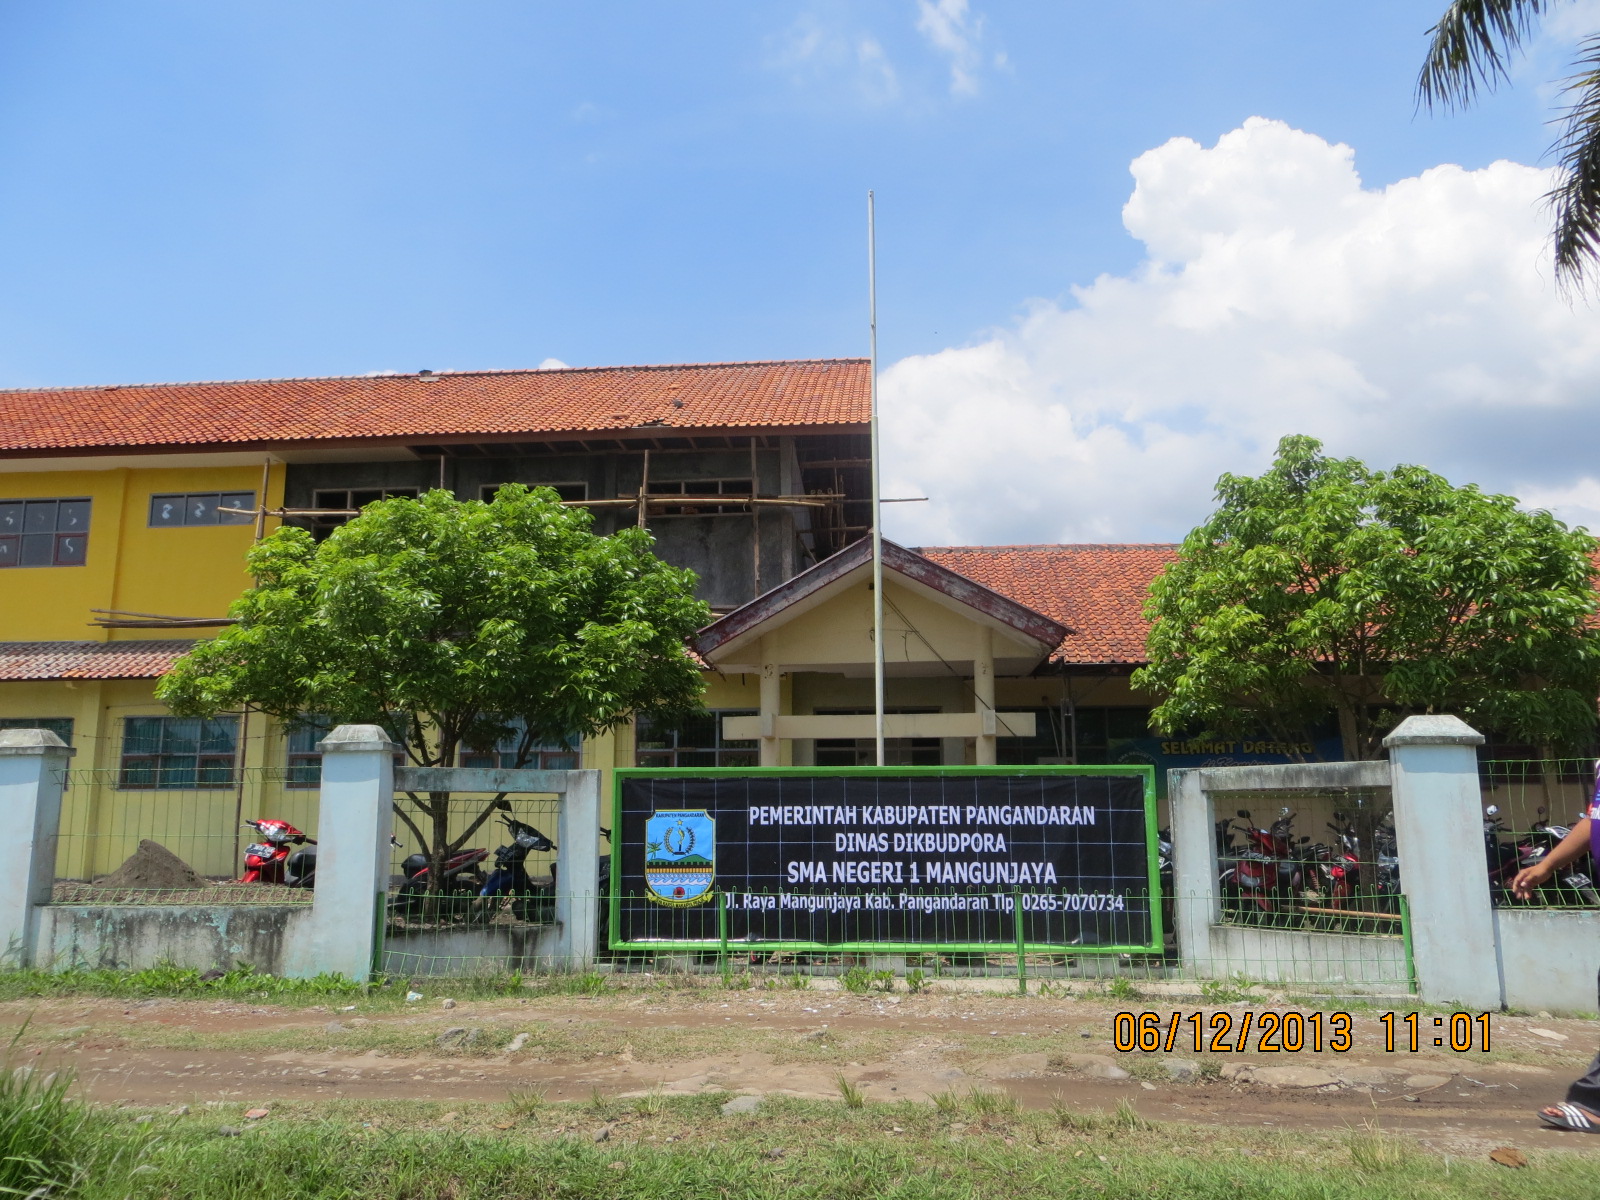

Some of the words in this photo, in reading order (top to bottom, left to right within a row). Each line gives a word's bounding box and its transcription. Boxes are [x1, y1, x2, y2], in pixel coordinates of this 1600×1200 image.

[1161, 740, 1236, 755] SELAMAT
[749, 806, 857, 825] PEMERINTAH
[862, 806, 961, 825] KABUPATEN
[966, 806, 1095, 825] PANGANDARAN
[835, 833, 889, 852] DINAS
[894, 833, 1006, 853] DIKBUDPORA
[787, 861, 828, 883] SMA
[833, 861, 903, 883] NEGERI
[909, 861, 920, 883] 1
[926, 861, 1057, 884] MANGUNJAYA
[725, 893, 739, 909] Jl.
[743, 893, 776, 912] Raya
[781, 893, 860, 913] Mangunjaya
[864, 893, 895, 911] Kab.
[899, 893, 989, 912] Pangandaran
[1021, 893, 1124, 911] 0265-7070734
